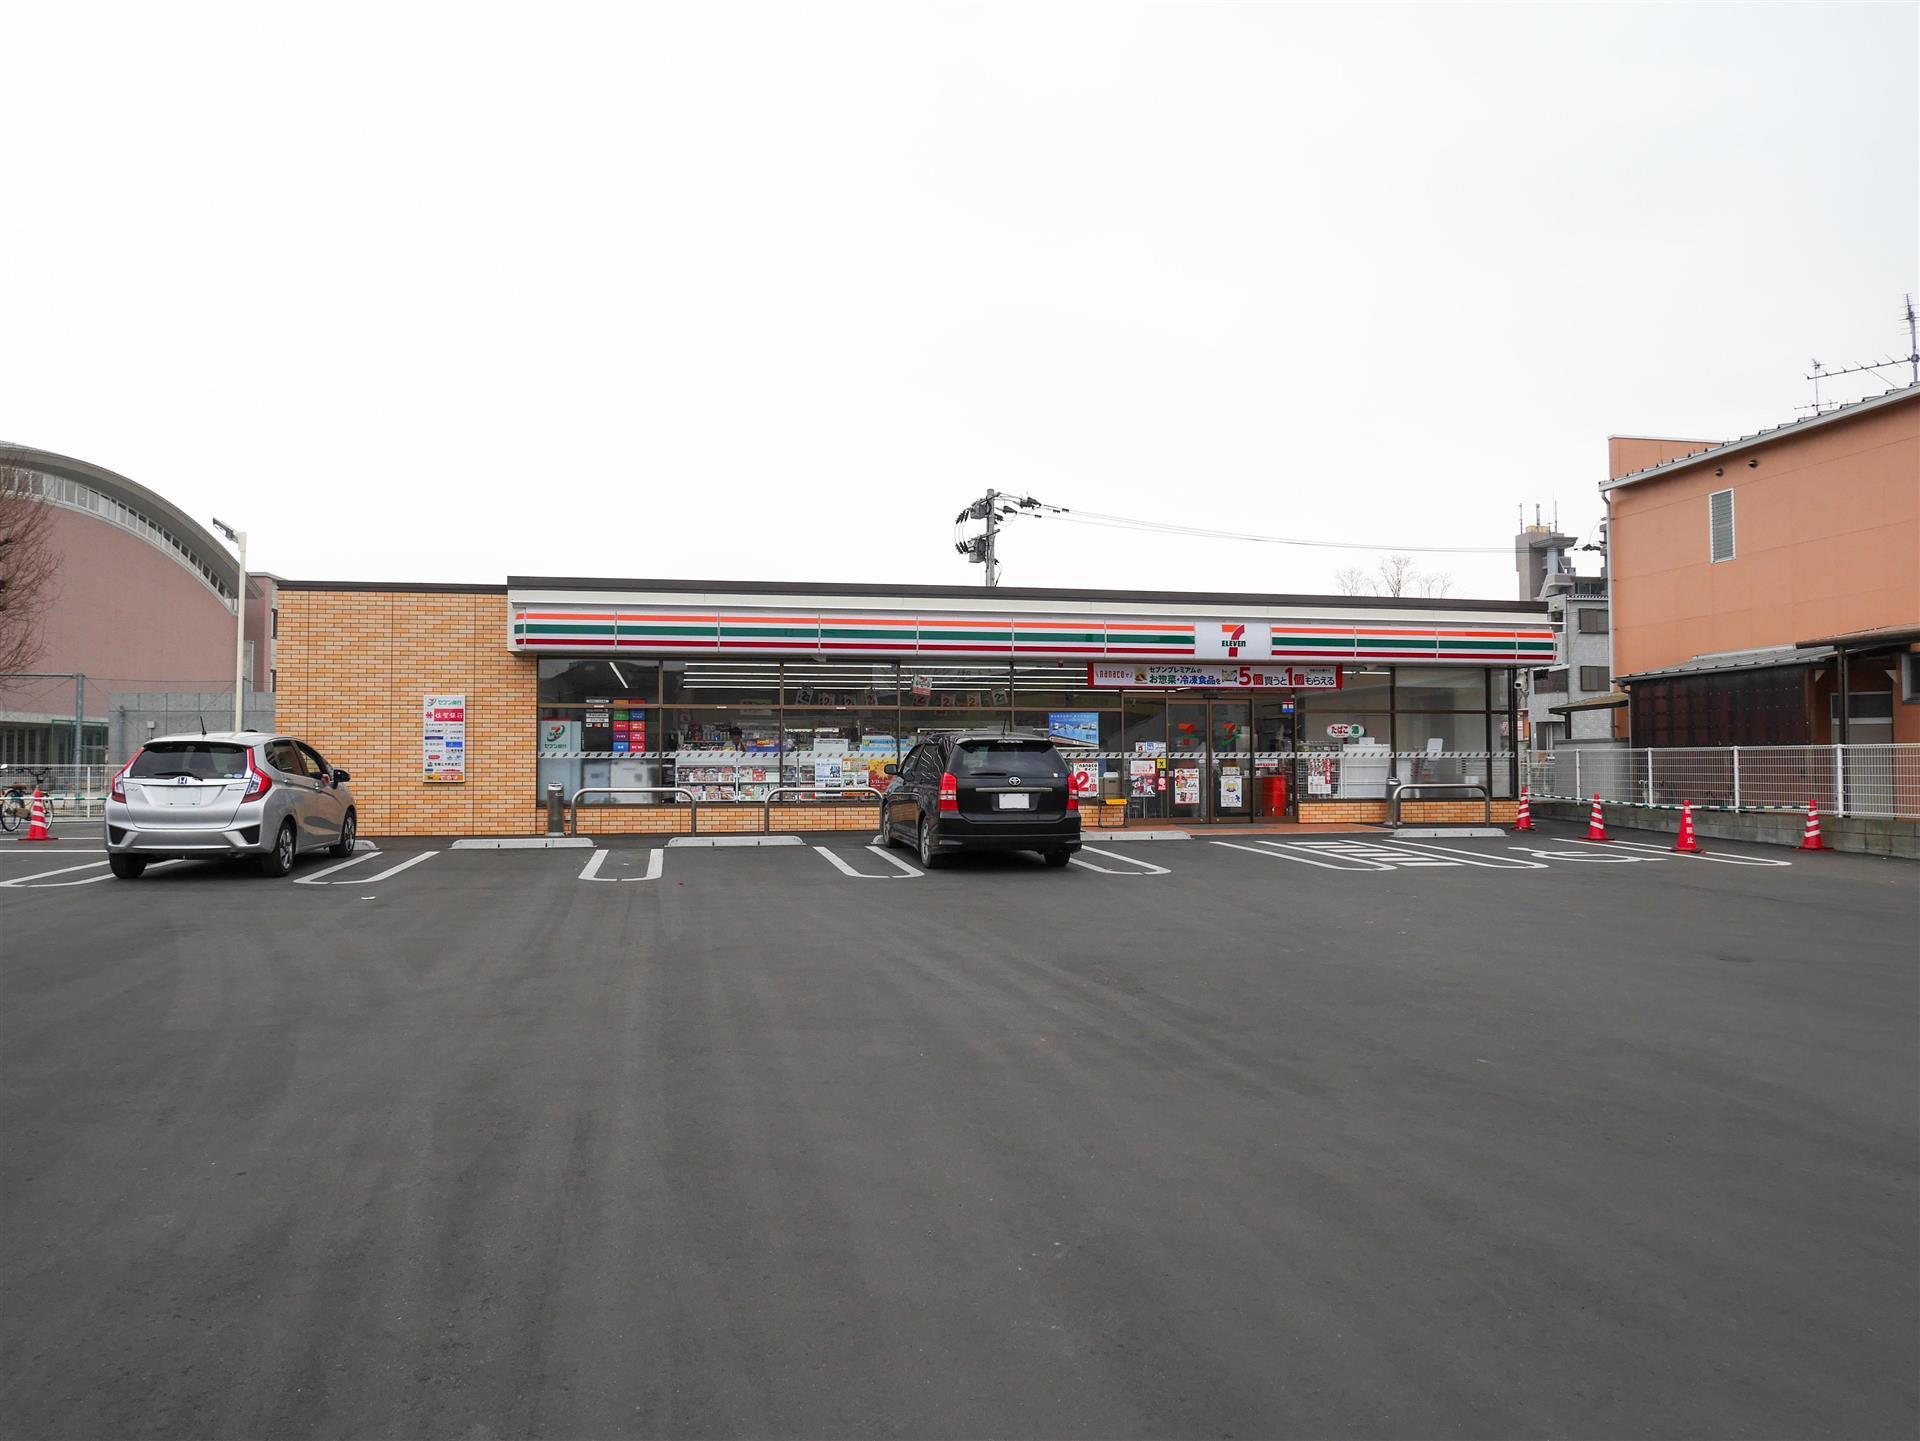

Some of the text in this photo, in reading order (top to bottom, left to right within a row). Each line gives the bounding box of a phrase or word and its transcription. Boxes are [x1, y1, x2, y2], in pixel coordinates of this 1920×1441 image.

[1221, 624, 1245, 657] 7
[1148, 666, 1202, 674] セブンプレミアムの
[1331, 725, 1349, 734] たばこ
